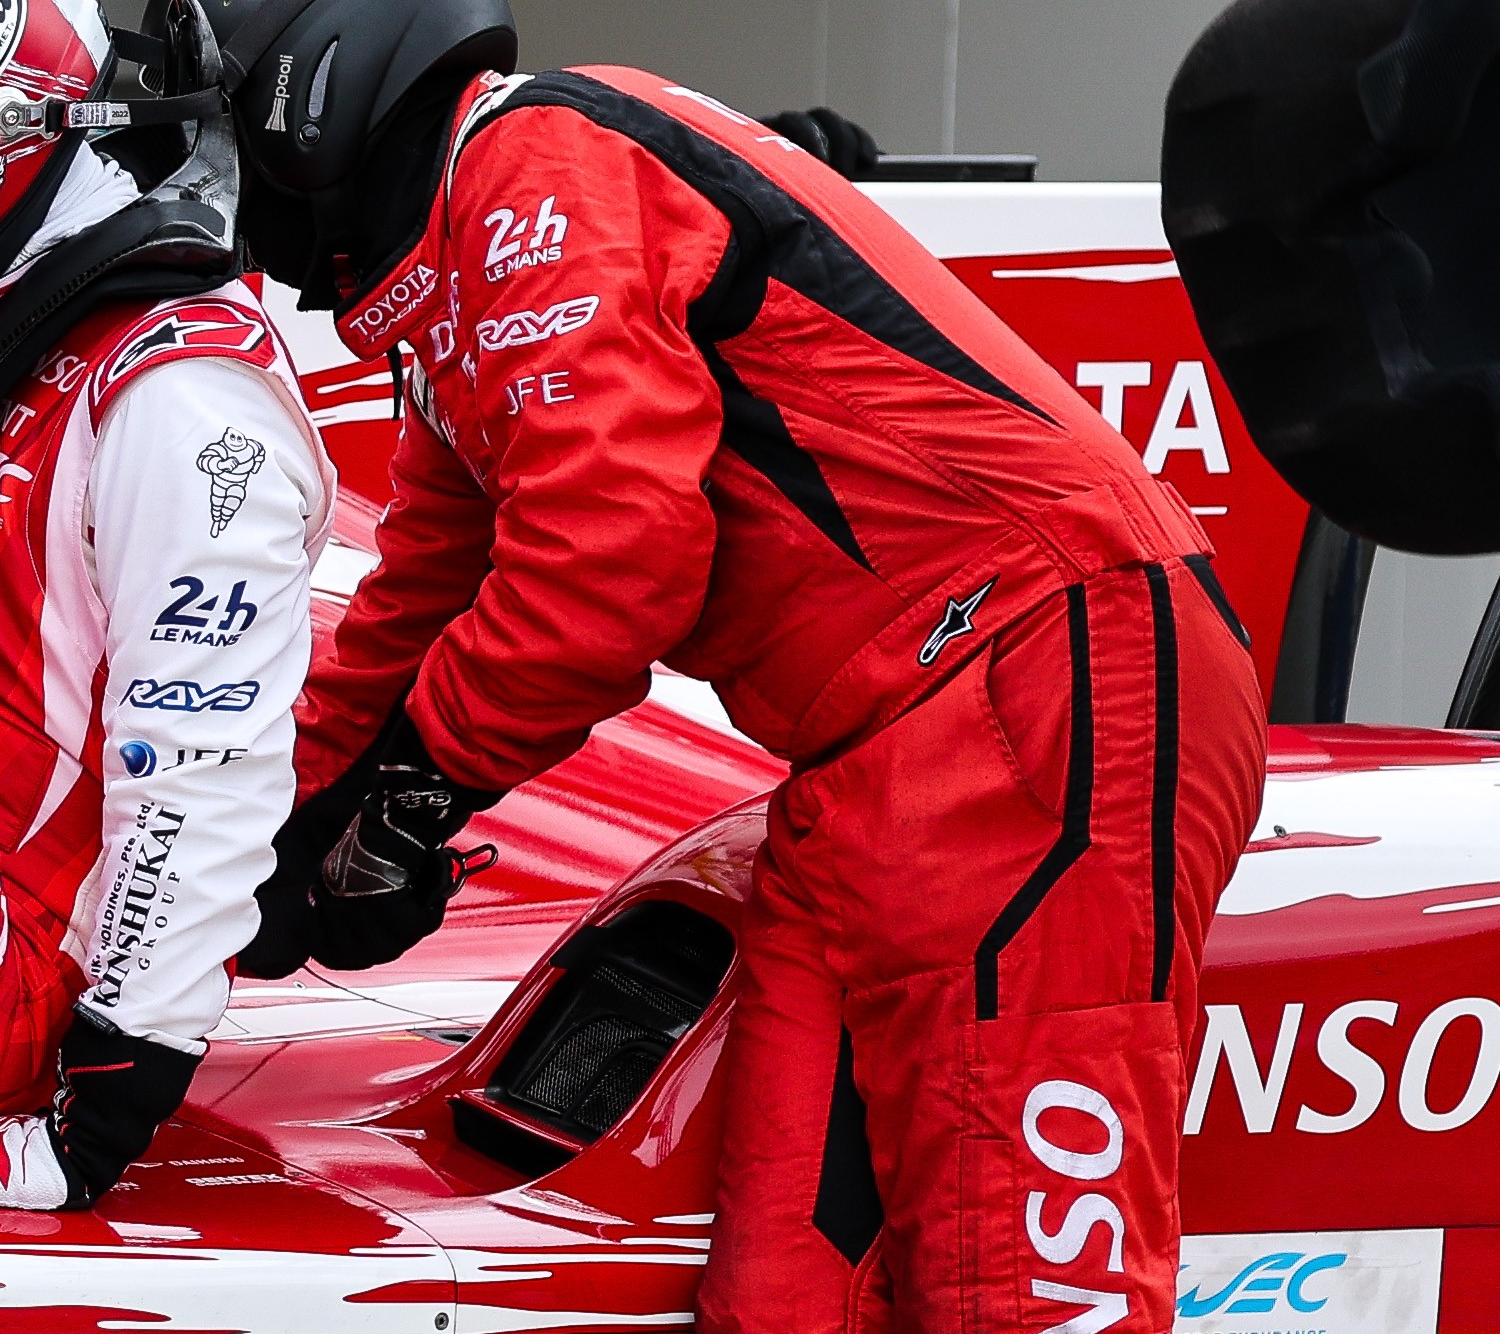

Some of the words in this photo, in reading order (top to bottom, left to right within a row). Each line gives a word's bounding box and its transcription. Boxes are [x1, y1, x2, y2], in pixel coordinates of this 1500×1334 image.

[277, 54, 293, 99] paoli
[111, 110, 129, 118] 2022
[482, 196, 568, 267] 24h
[485, 265, 507, 283] LE
[507, 247, 563, 275] MANS
[350, 264, 437, 334] TOYOTA
[363, 274, 440, 344] RACING
[472, 295, 601, 351] RAYS
[507, 372, 576, 416] JFE
[154, 574, 259, 632] 24h
[149, 627, 178, 643] LE
[179, 629, 244, 649] MANS
[117, 678, 262, 713] RAYS
[136, 799, 157, 827] Ltd.
[91, 806, 187, 1010] KINSHUKAI
[169, 1157, 245, 1167] DAIHATSU
